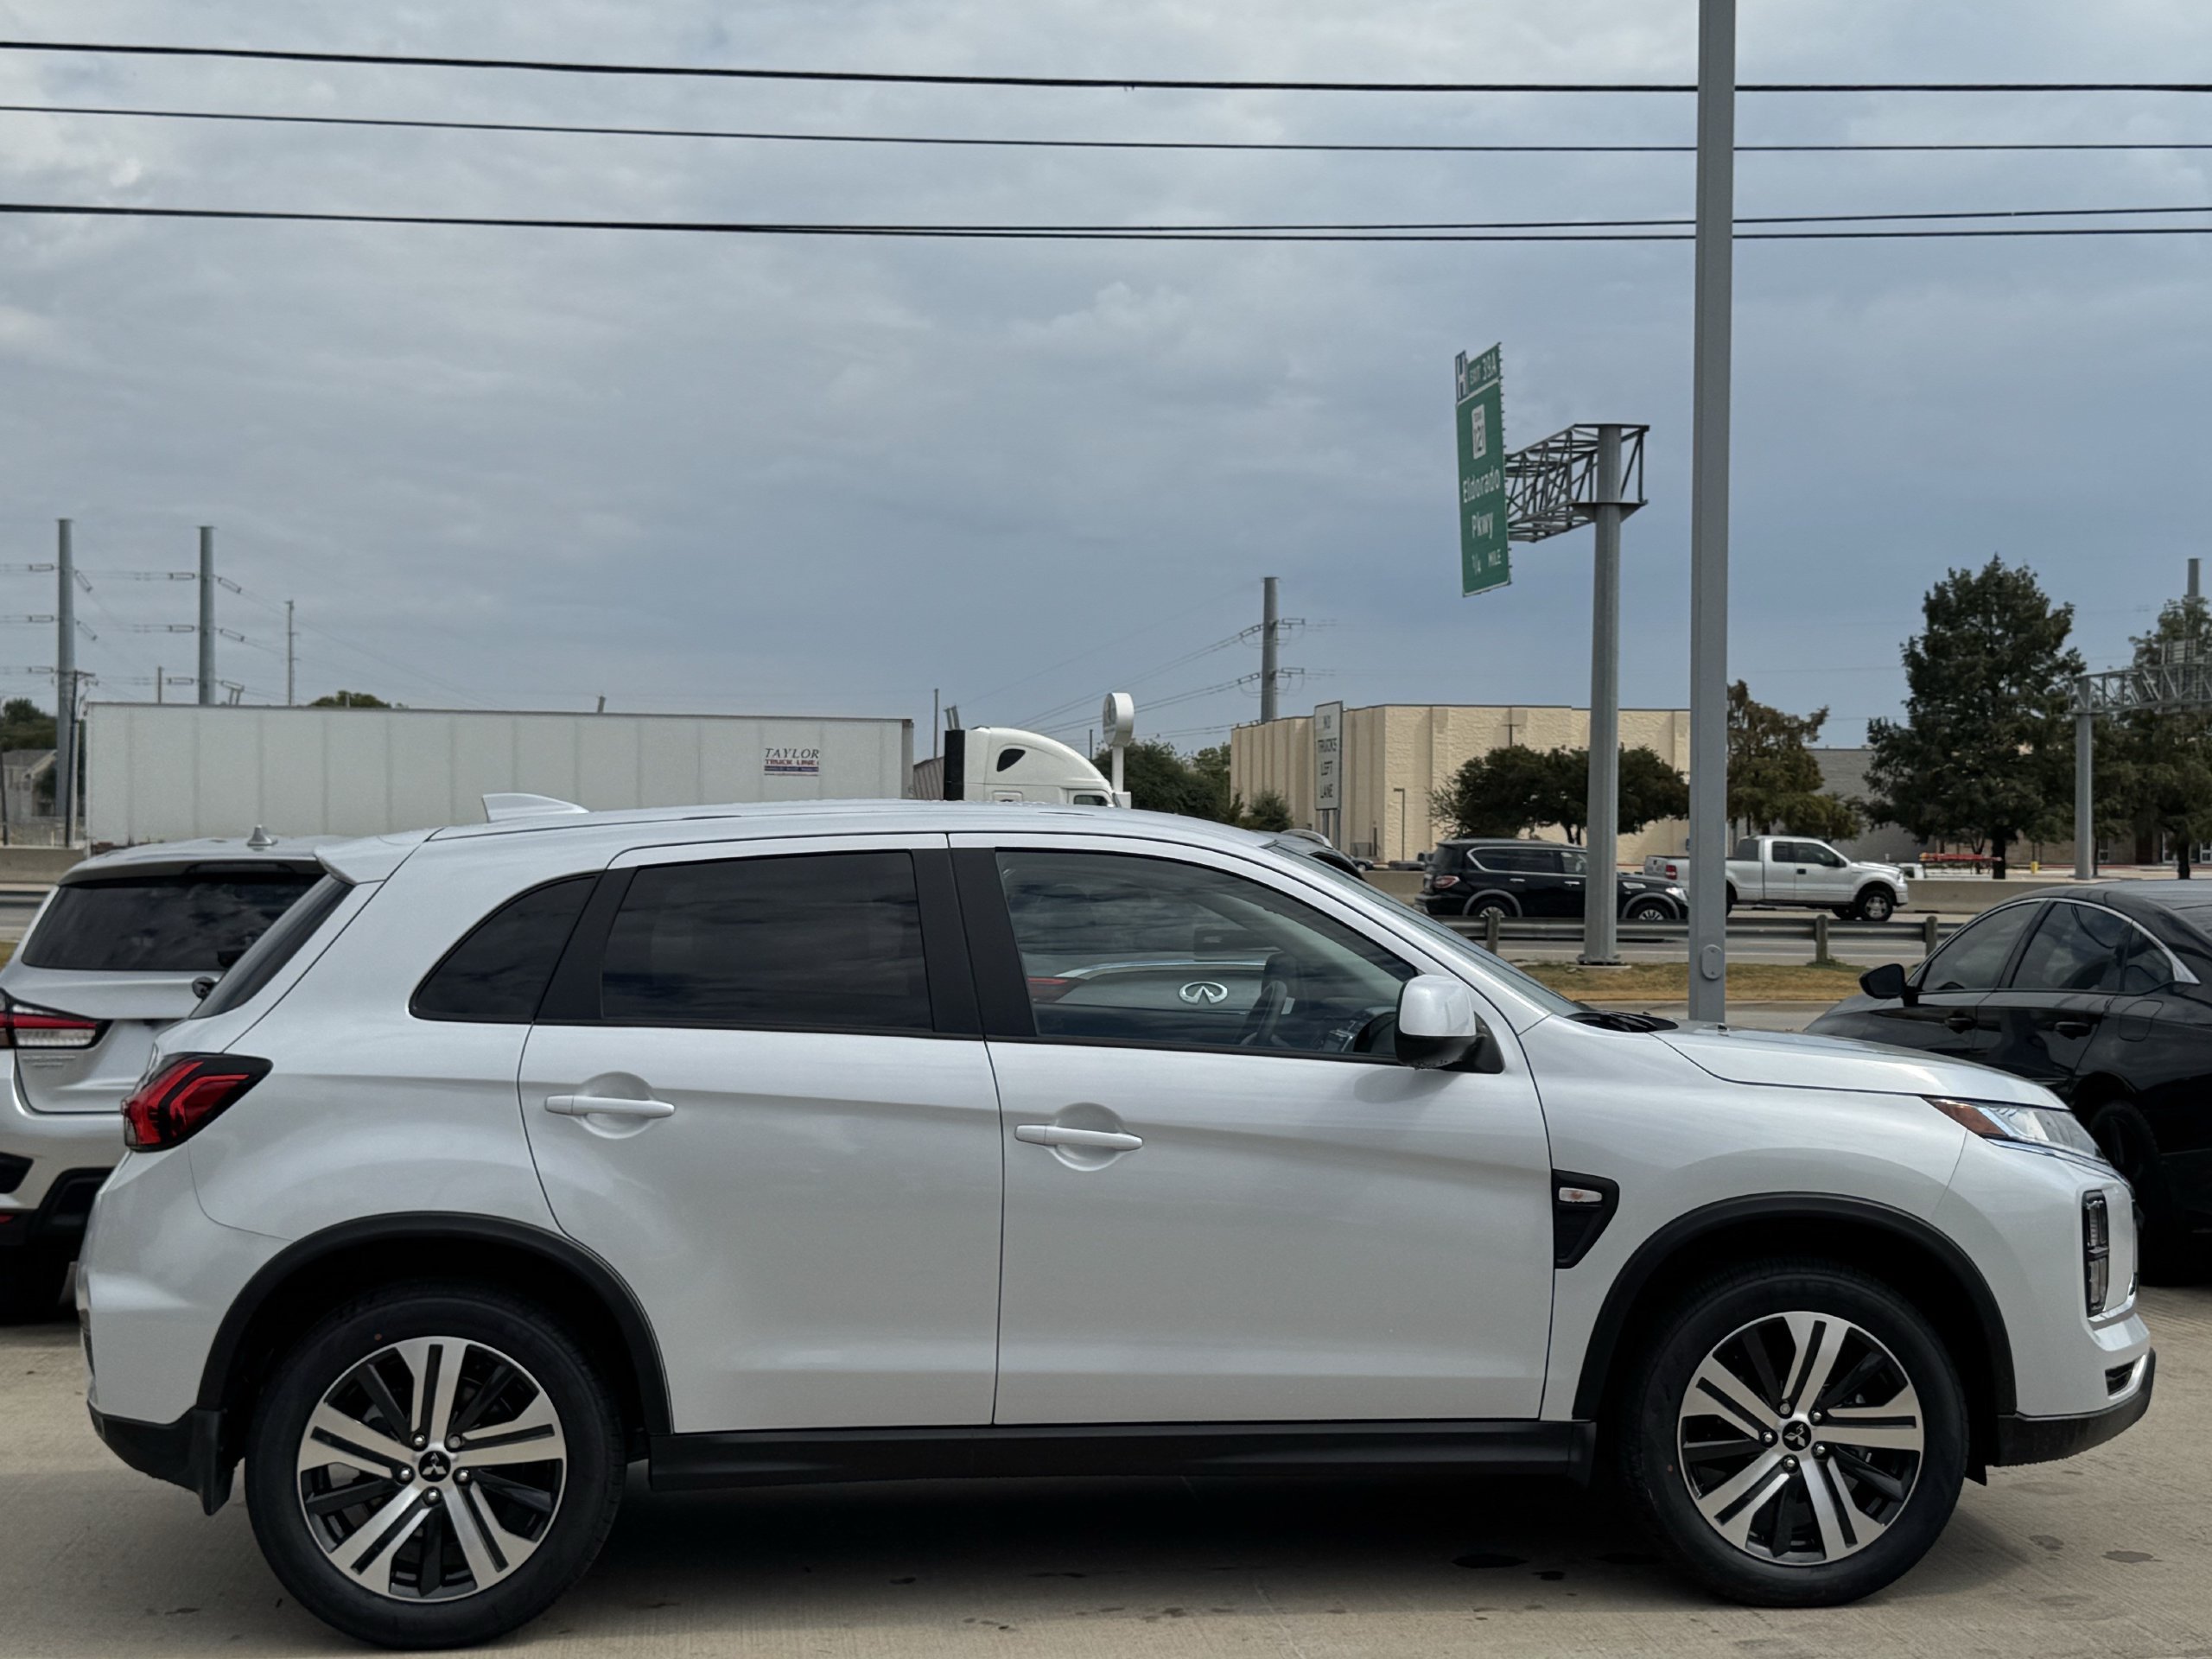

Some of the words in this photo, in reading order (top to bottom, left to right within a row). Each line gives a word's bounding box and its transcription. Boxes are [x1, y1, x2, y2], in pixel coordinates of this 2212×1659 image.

[1463, 465, 1501, 504] Eldorado
[1471, 512, 1494, 540] Pkwy
[1488, 548, 1502, 568] MILE
[765, 747, 820, 759] TAYLOR
[1317, 737, 1338, 753] TRUCKS
[1320, 760, 1333, 776] LEFT
[1319, 783, 1333, 799] LANE
